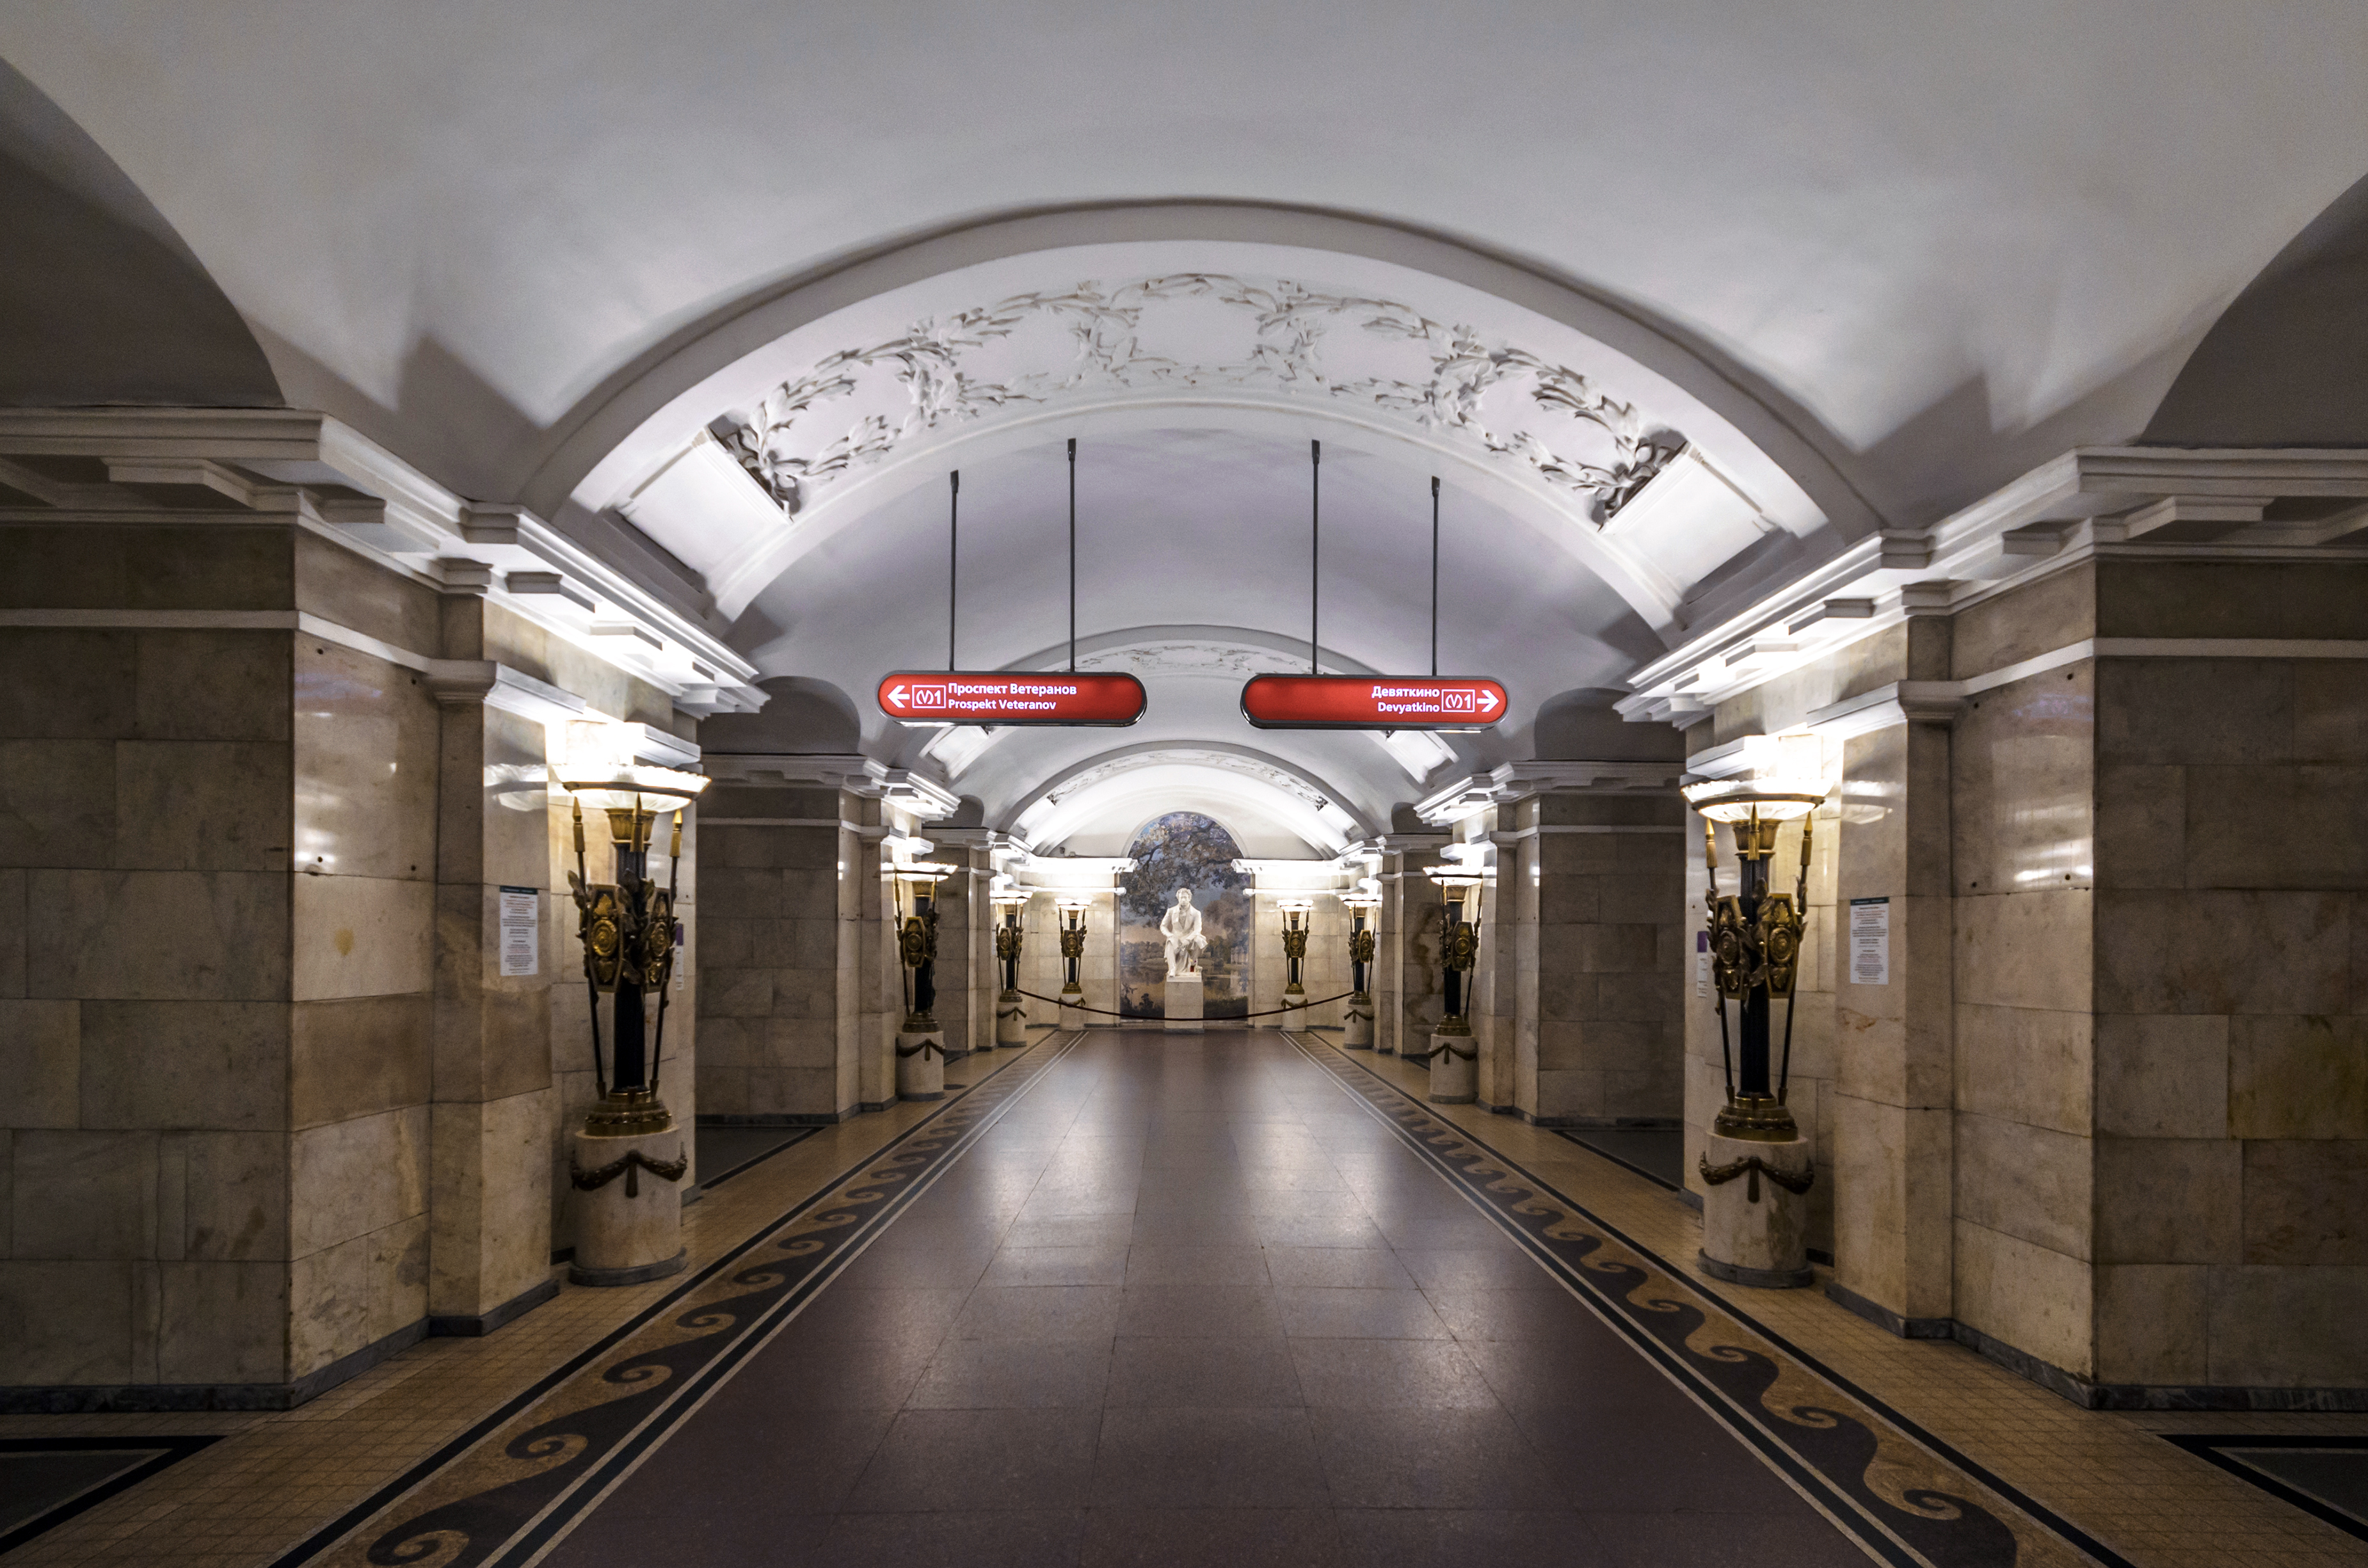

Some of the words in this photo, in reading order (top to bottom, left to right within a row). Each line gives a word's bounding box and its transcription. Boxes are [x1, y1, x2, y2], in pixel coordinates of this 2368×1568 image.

[948, 682, 1008, 697] Проспект
[1010, 683, 1077, 697] Ветеранов
[1372, 685, 1440, 699] Девяткино
[948, 698, 996, 711] Prospekt
[998, 699, 1057, 710] Veteranov
[1378, 701, 1440, 714] Devyatkino
